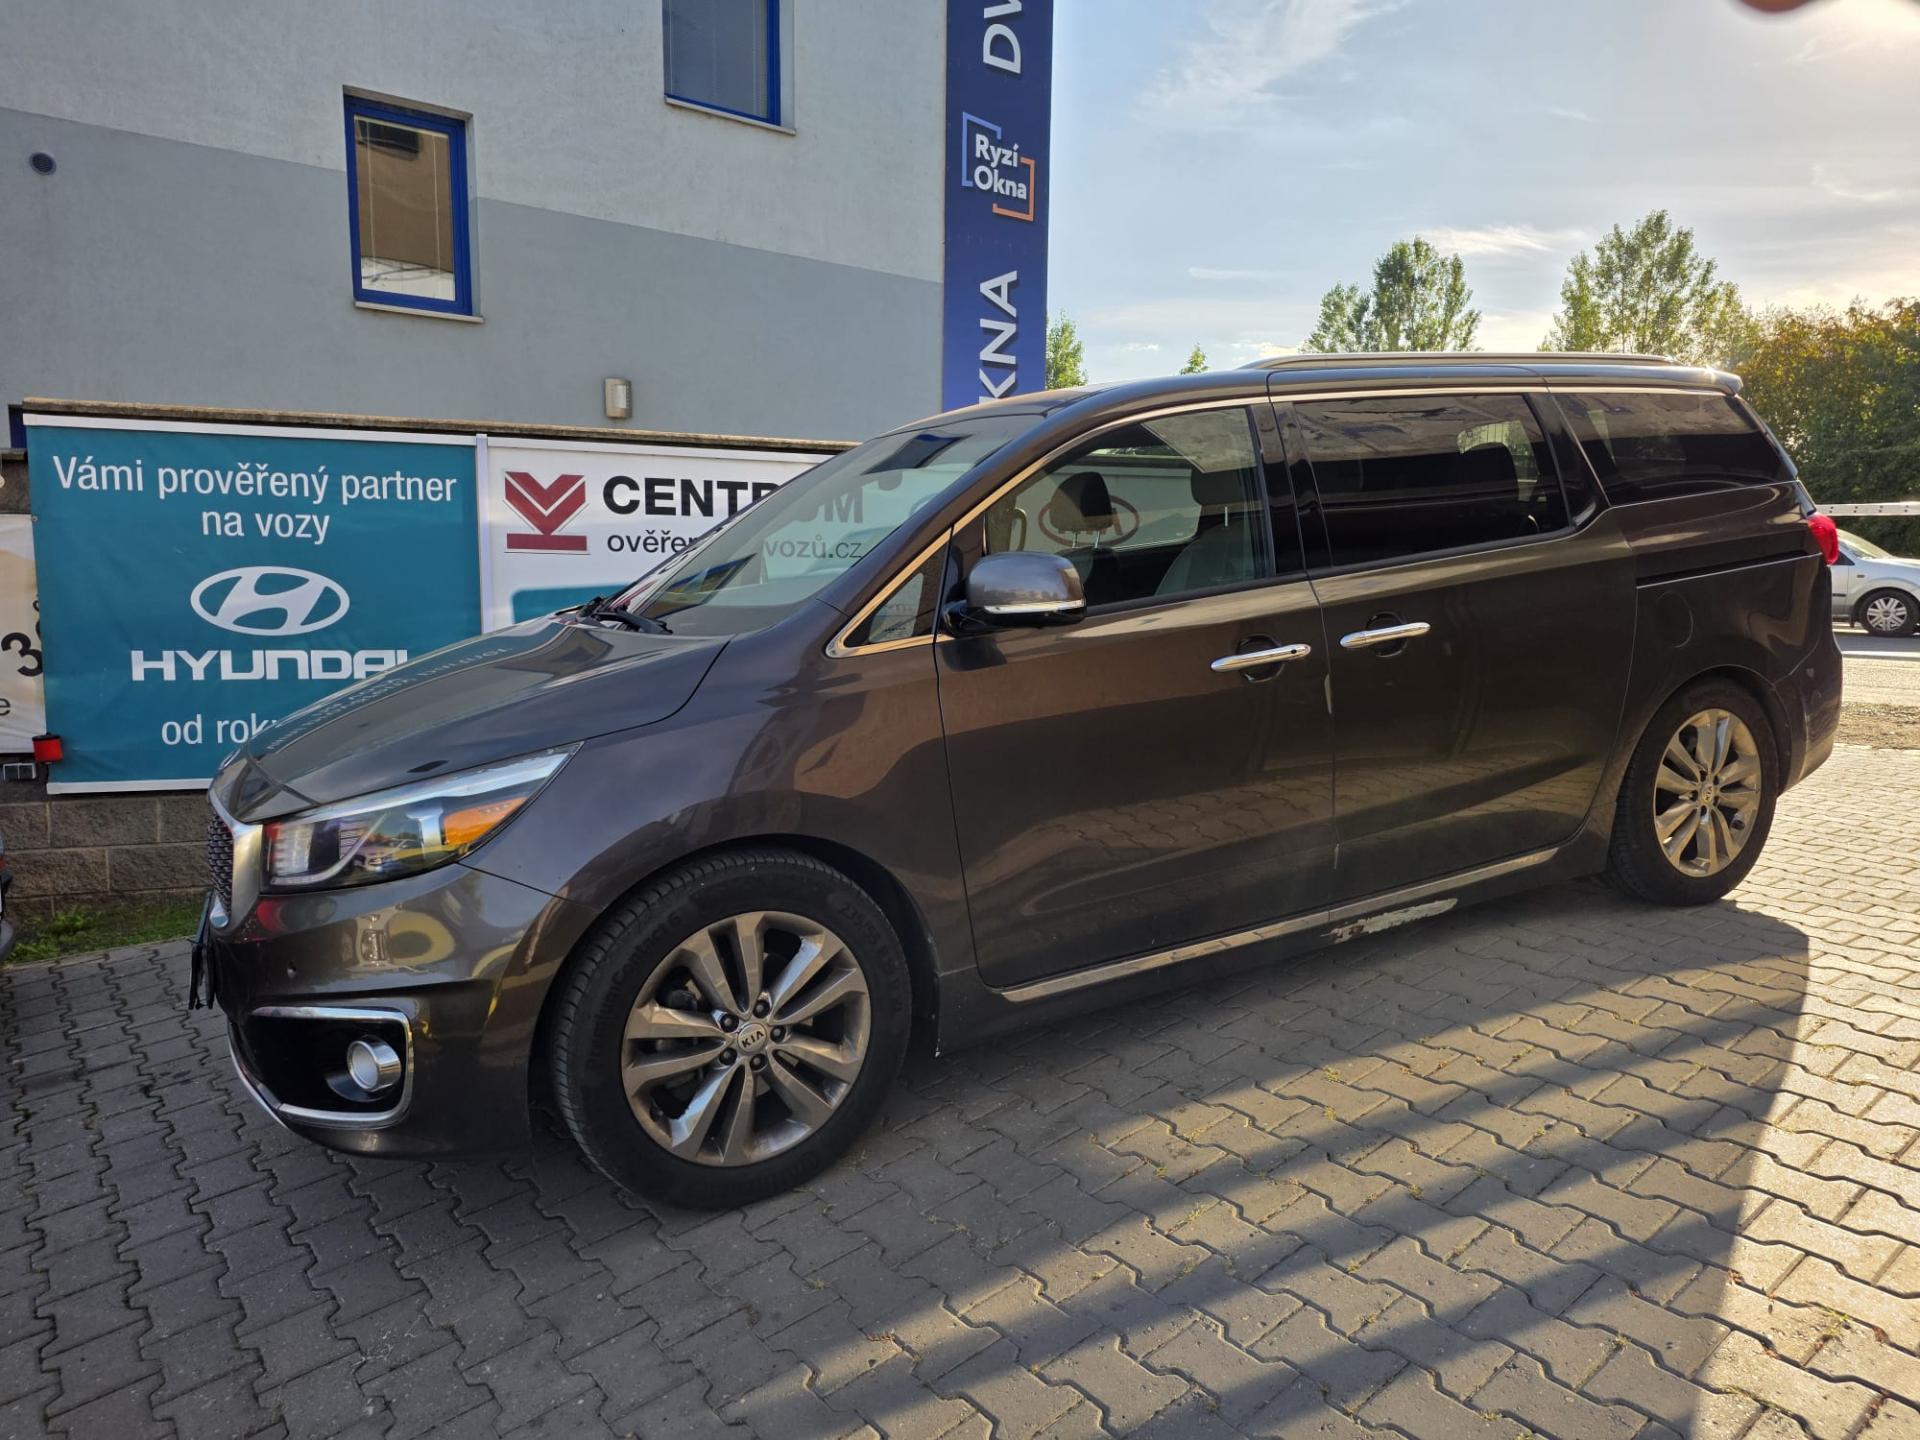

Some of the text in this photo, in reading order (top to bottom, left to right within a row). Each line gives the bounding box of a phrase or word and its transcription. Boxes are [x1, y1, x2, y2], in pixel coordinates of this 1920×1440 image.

[974, 165, 1027, 200] Okna
[52, 455, 457, 505] Vámi prověřený partner
[201, 510, 330, 545] na vozy
[765, 534, 863, 559] vozů.cz
[161, 713, 203, 745] od
[217, 712, 277, 744] rok
[741, 1030, 765, 1048] KIA
